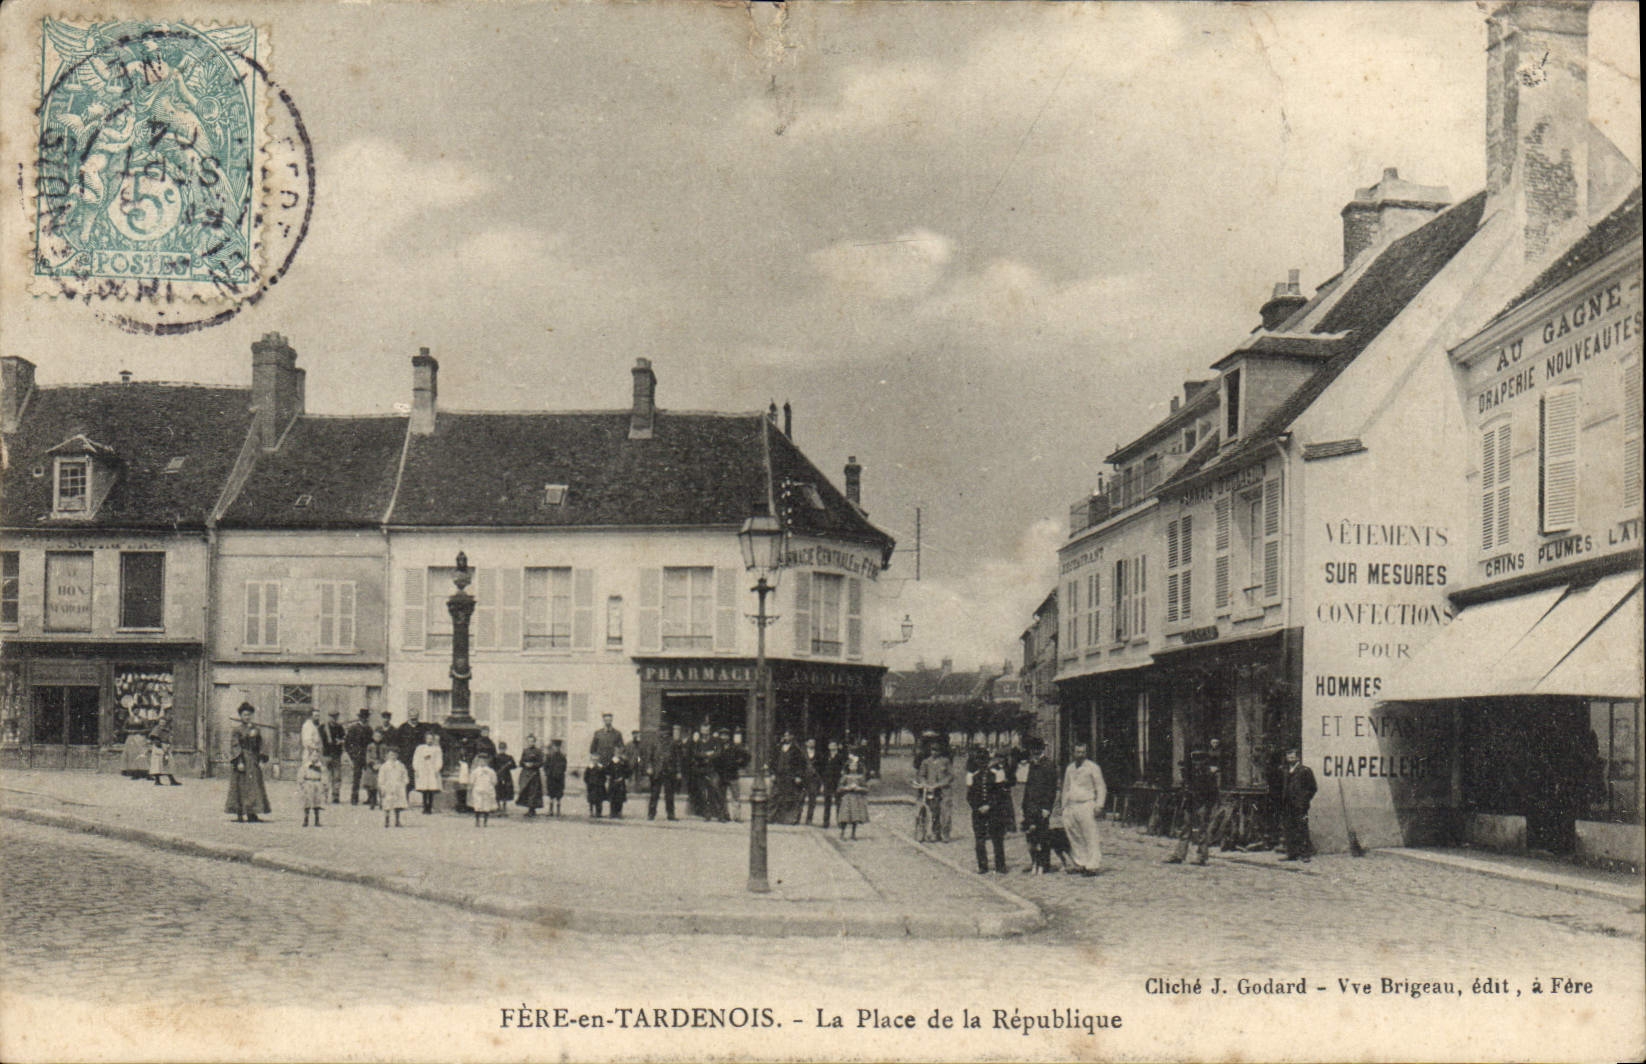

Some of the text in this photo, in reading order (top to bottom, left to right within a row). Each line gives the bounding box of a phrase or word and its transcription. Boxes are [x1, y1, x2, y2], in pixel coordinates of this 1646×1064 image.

[95, 251, 189, 276] POSTES
[1496, 337, 1524, 372] AU
[1478, 366, 1536, 414] DRAPERIE
[1325, 519, 1449, 546] VÊTEMENTS
[1486, 553, 1525, 577] CRINS
[1538, 535, 1593, 564] PLUMES
[1325, 562, 1447, 585] SUR MESURES
[1317, 602, 1453, 626] CONFECTIONS
[1357, 642, 1412, 659] POUR
[1315, 676, 1382, 697] HOMMES
[1321, 715, 1342, 736] ET
